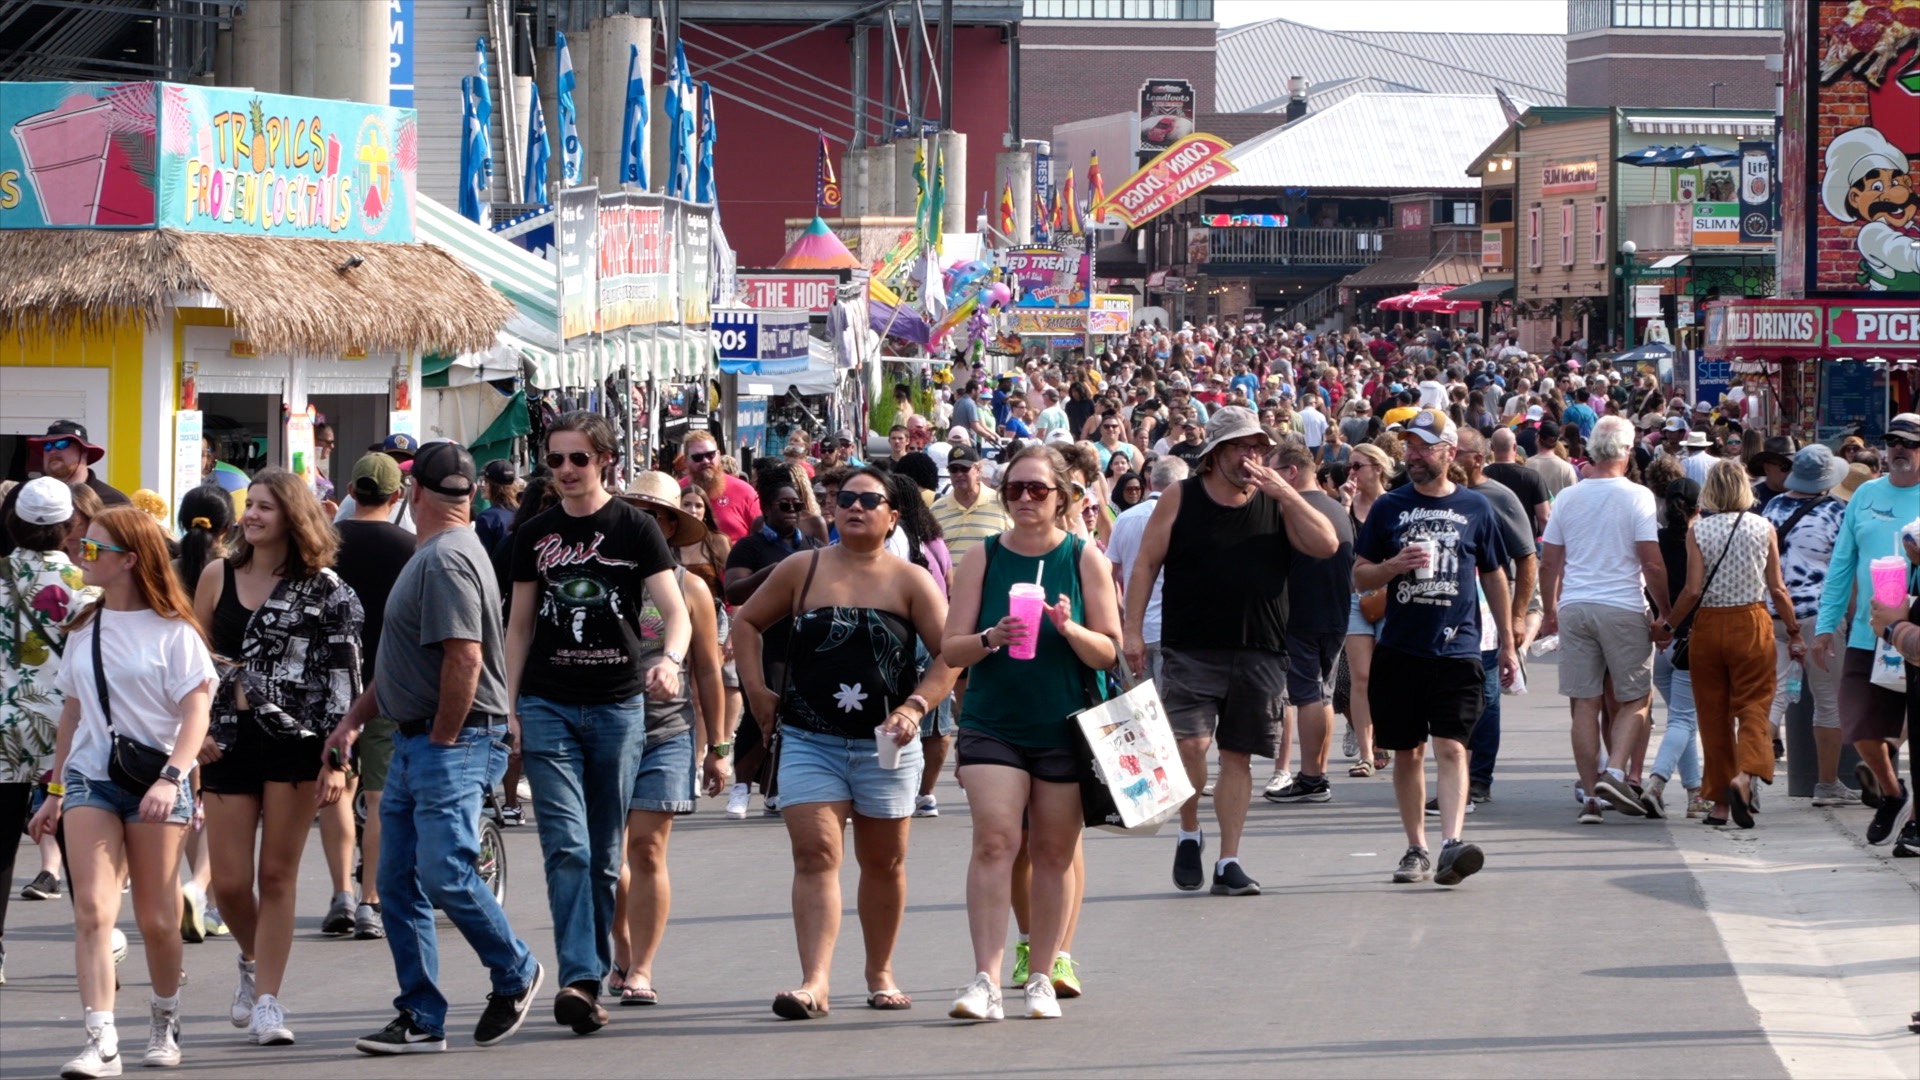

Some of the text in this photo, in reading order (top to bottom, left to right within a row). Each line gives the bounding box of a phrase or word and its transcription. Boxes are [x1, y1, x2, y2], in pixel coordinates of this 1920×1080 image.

[1747, 161, 1768, 176] Lite
[185, 158, 350, 233] FROZEN COCKTAILS
[1696, 219, 1726, 230] SLIM
[1031, 256, 1080, 275] TREATS
[754, 282, 828, 308] THE HOG
[1033, 285, 1070, 301] Twinkies
[1753, 312, 1813, 340] DRINKS
[1698, 362, 1729, 379] SEE
[1399, 507, 1468, 525] Milwaukee
[1396, 580, 1459, 603] Brewers
